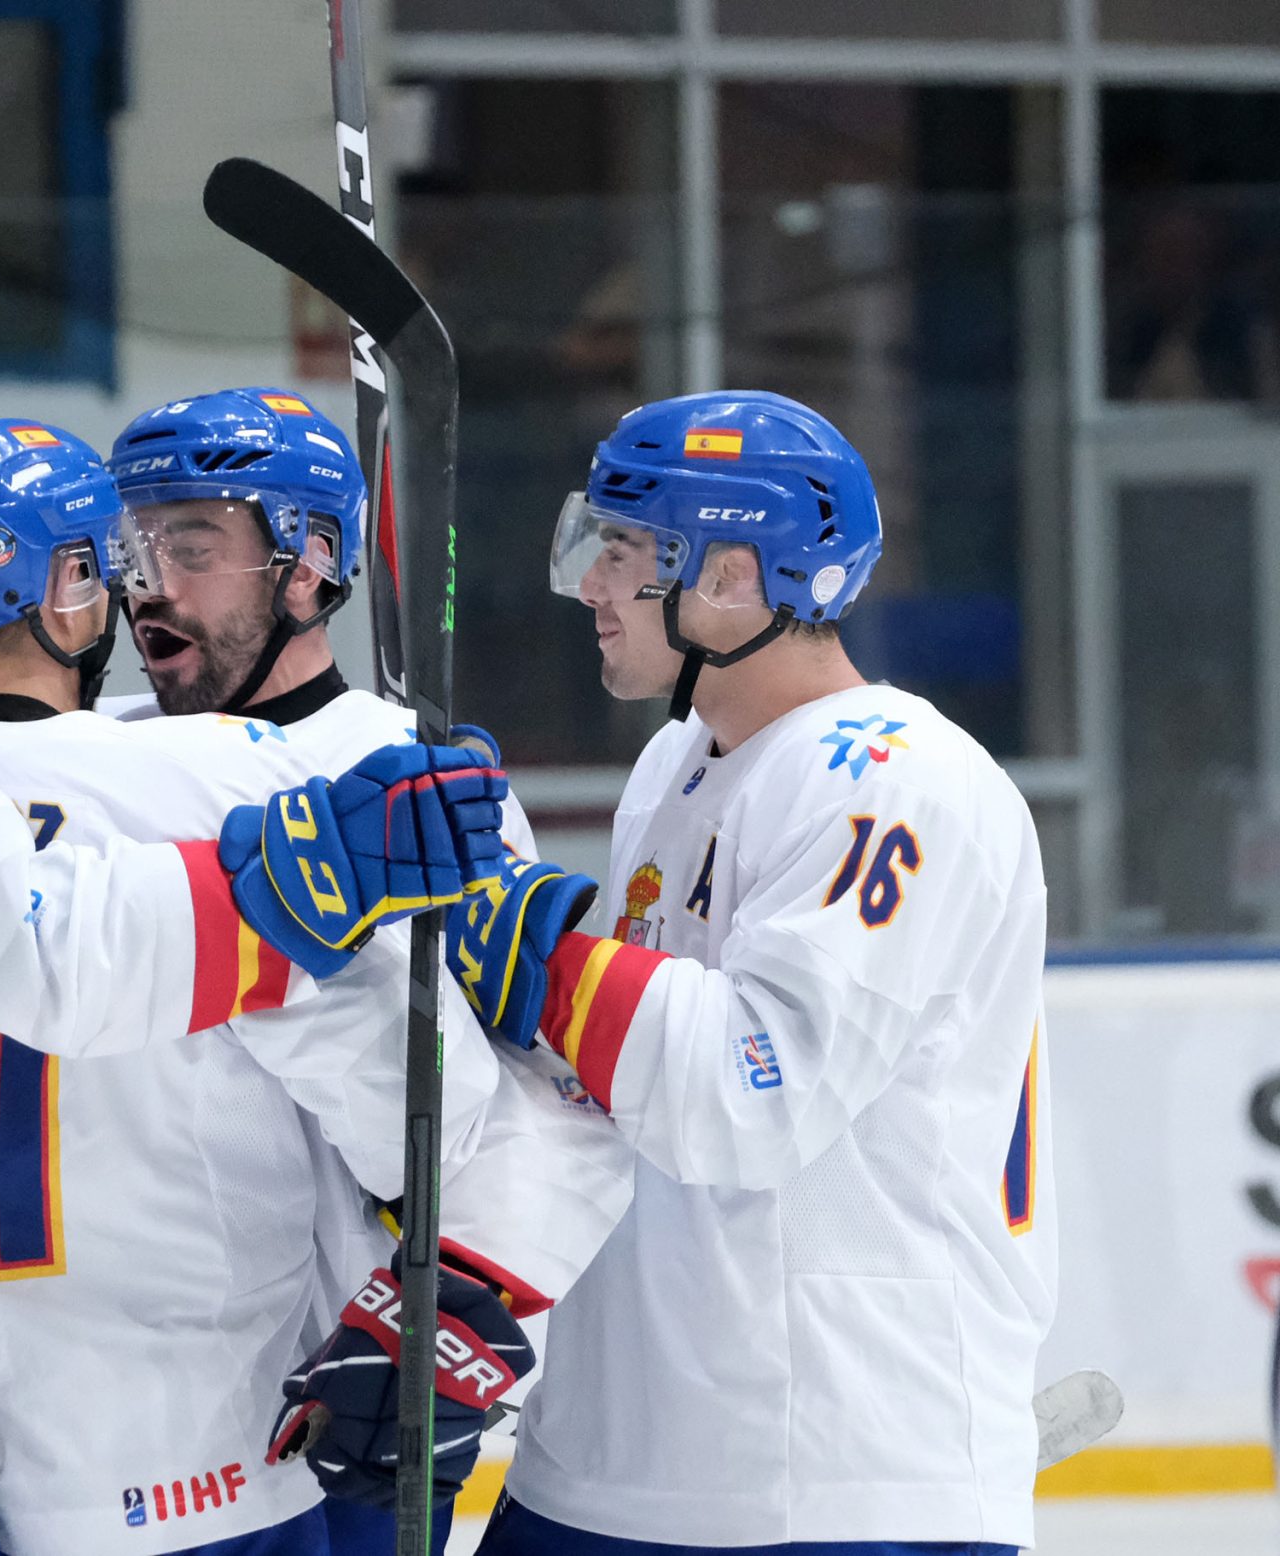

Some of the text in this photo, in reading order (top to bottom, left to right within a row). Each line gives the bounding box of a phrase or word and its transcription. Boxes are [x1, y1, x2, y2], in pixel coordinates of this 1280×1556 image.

[309, 464, 343, 481] CCM
[65, 494, 94, 511] CCM
[697, 507, 767, 522] CCM
[821, 812, 924, 931] 16
[152, 1461, 247, 1522] IIHF
